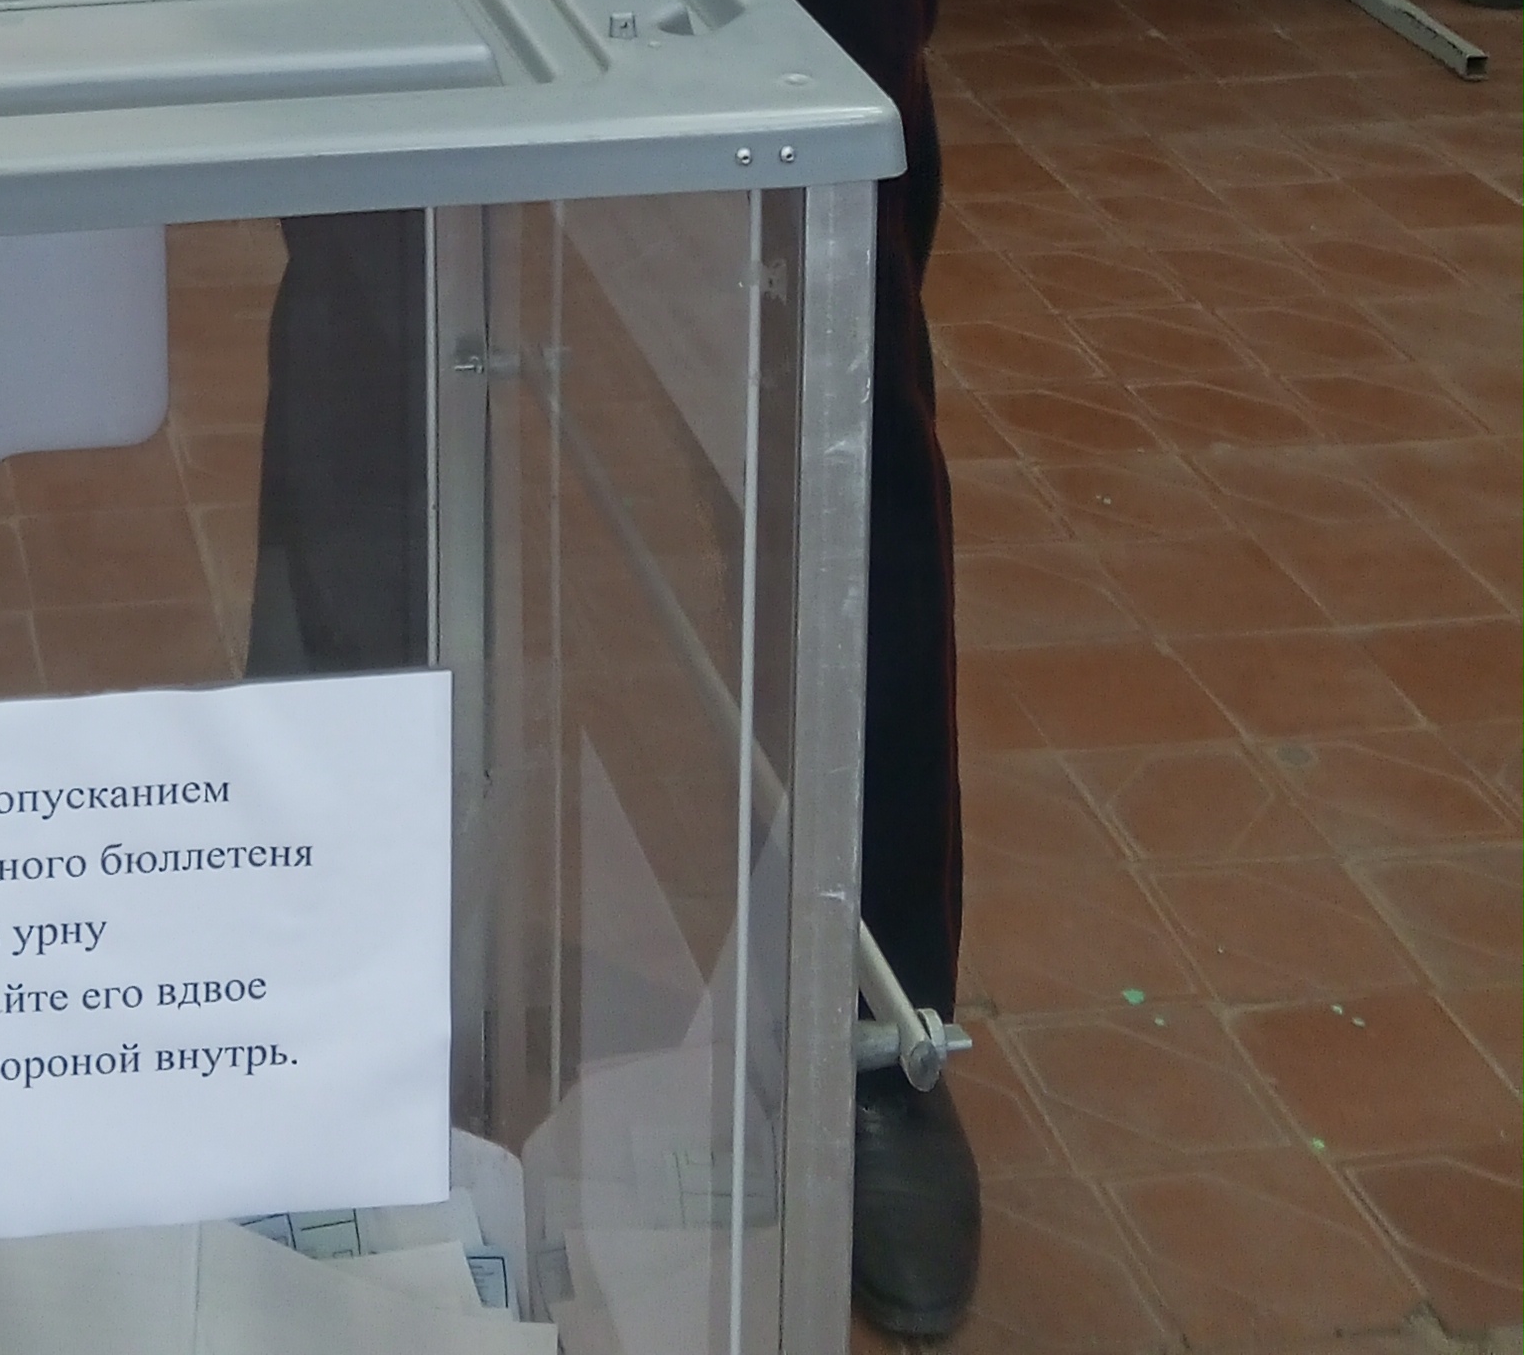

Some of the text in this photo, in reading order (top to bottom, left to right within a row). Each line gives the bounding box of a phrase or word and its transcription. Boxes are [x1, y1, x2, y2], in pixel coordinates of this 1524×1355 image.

[100, 843, 313, 877] бюллетеня
[12, 919, 108, 956] урну
[81, 985, 143, 1012] его
[157, 977, 268, 1010] вдвое
[155, 1041, 299, 1080] внутрь.
